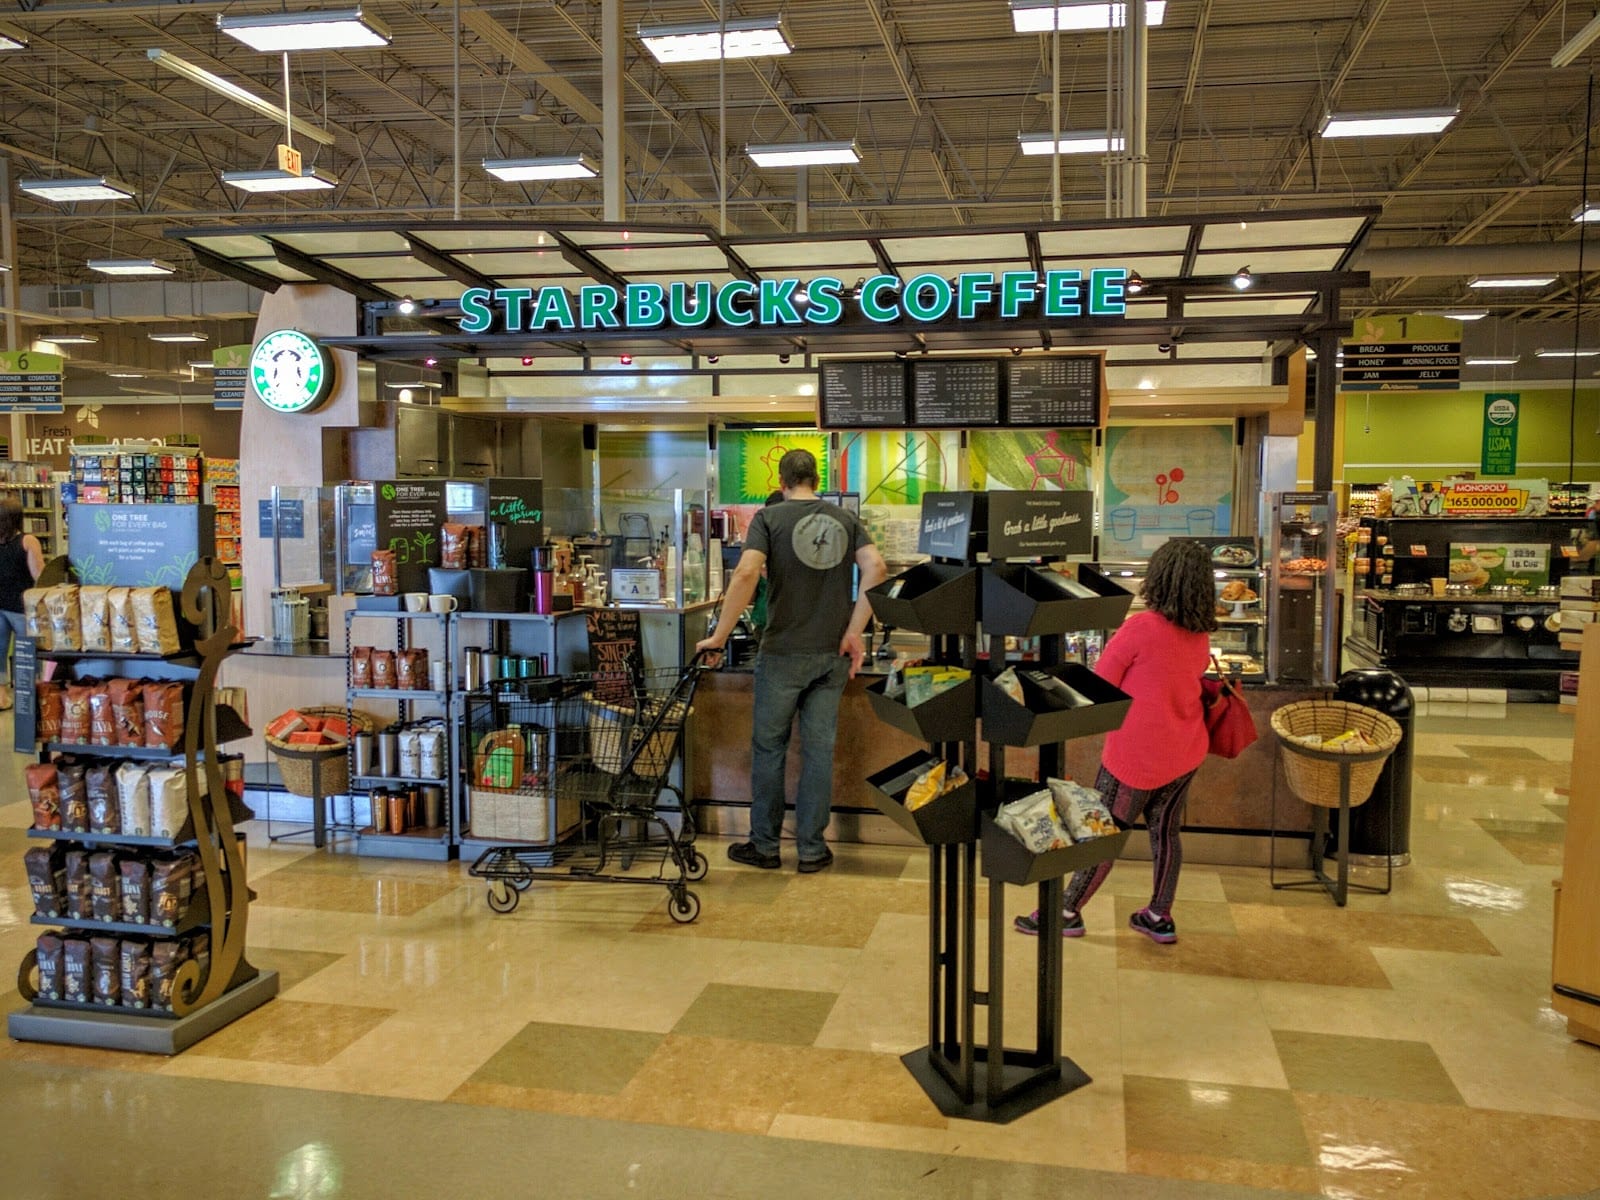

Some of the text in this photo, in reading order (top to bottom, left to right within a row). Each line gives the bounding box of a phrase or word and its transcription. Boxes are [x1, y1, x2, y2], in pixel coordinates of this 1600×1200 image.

[286, 149, 299, 172] EXIT
[459, 268, 1128, 332] STARBUCKS COFFEE
[1398, 317, 1408, 338] 1
[1412, 344, 1449, 352] PRODUCE
[17, 353, 29, 370] 6
[1358, 357, 1458, 367] HONEY MORNING FOODS
[1362, 371, 1441, 380] JAM JELLY
[42, 425, 72, 437] Fresh
[1488, 437, 1511, 451] USDA
[1456, 484, 1506, 492] MONOPOLY
[500, 498, 527, 516] little
[1446, 497, 1518, 507] $165,000,000
[509, 510, 542, 524] spring
[1004, 519, 1023, 536] Grab
[1023, 523, 1030, 533] a
[1031, 514, 1048, 531] little
[1505, 578, 1530, 586] Soup
[631, 585, 639, 594] A
[601, 612, 615, 621] ONE
